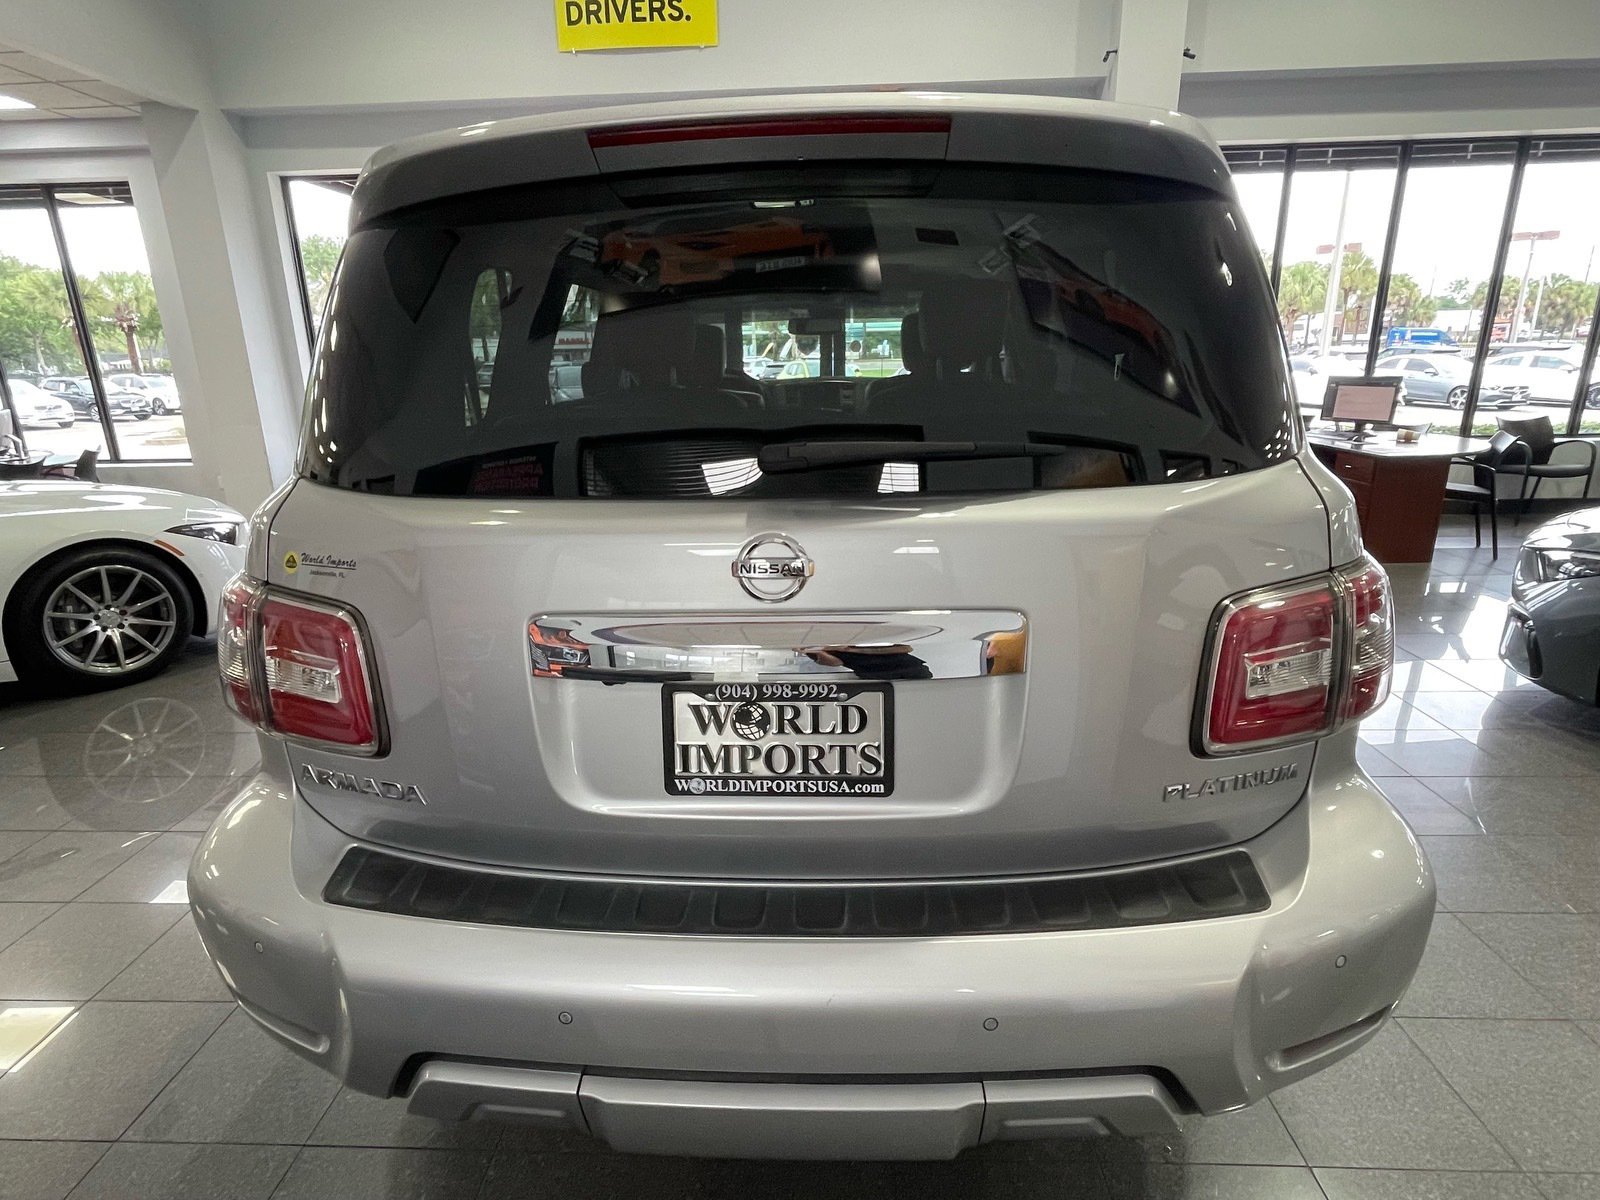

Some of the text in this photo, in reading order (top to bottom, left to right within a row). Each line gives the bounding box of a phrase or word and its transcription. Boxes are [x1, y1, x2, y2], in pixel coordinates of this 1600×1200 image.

[565, 0, 692, 26] DRIVERS.
[301, 552, 357, 568] World Imports
[740, 561, 805, 576] NISSAN
[715, 683, 838, 701] (904) 998-9992
[675, 742, 884, 777] IMPORTS
[302, 763, 428, 806] ARMADA
[1162, 762, 1298, 802] PLATINUM
